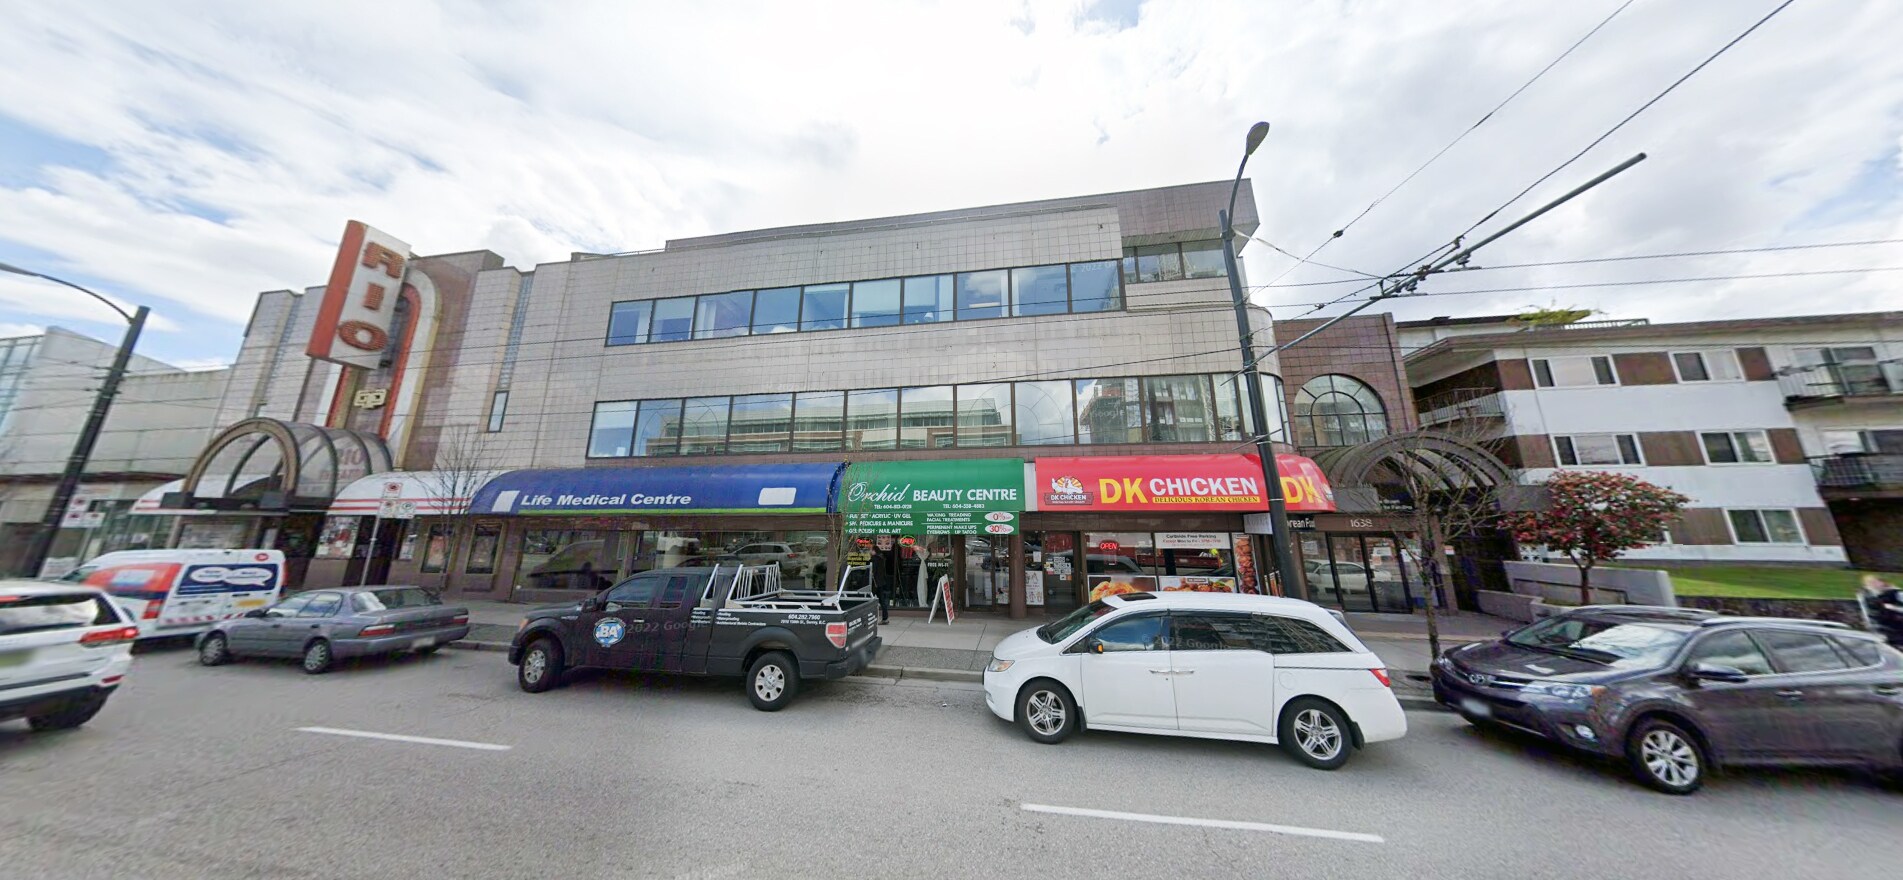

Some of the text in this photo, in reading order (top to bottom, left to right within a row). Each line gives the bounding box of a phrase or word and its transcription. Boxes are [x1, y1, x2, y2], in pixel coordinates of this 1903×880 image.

[338, 241, 405, 351] RIO
[520, 494, 692, 506] Life Medical Centre
[848, 482, 1017, 502] Orchid BEAUTY CENTRE
[1099, 477, 1259, 504] DK CHICKEN
[1280, 476, 1323, 504] DK
[1350, 519, 1373, 528] 1638
